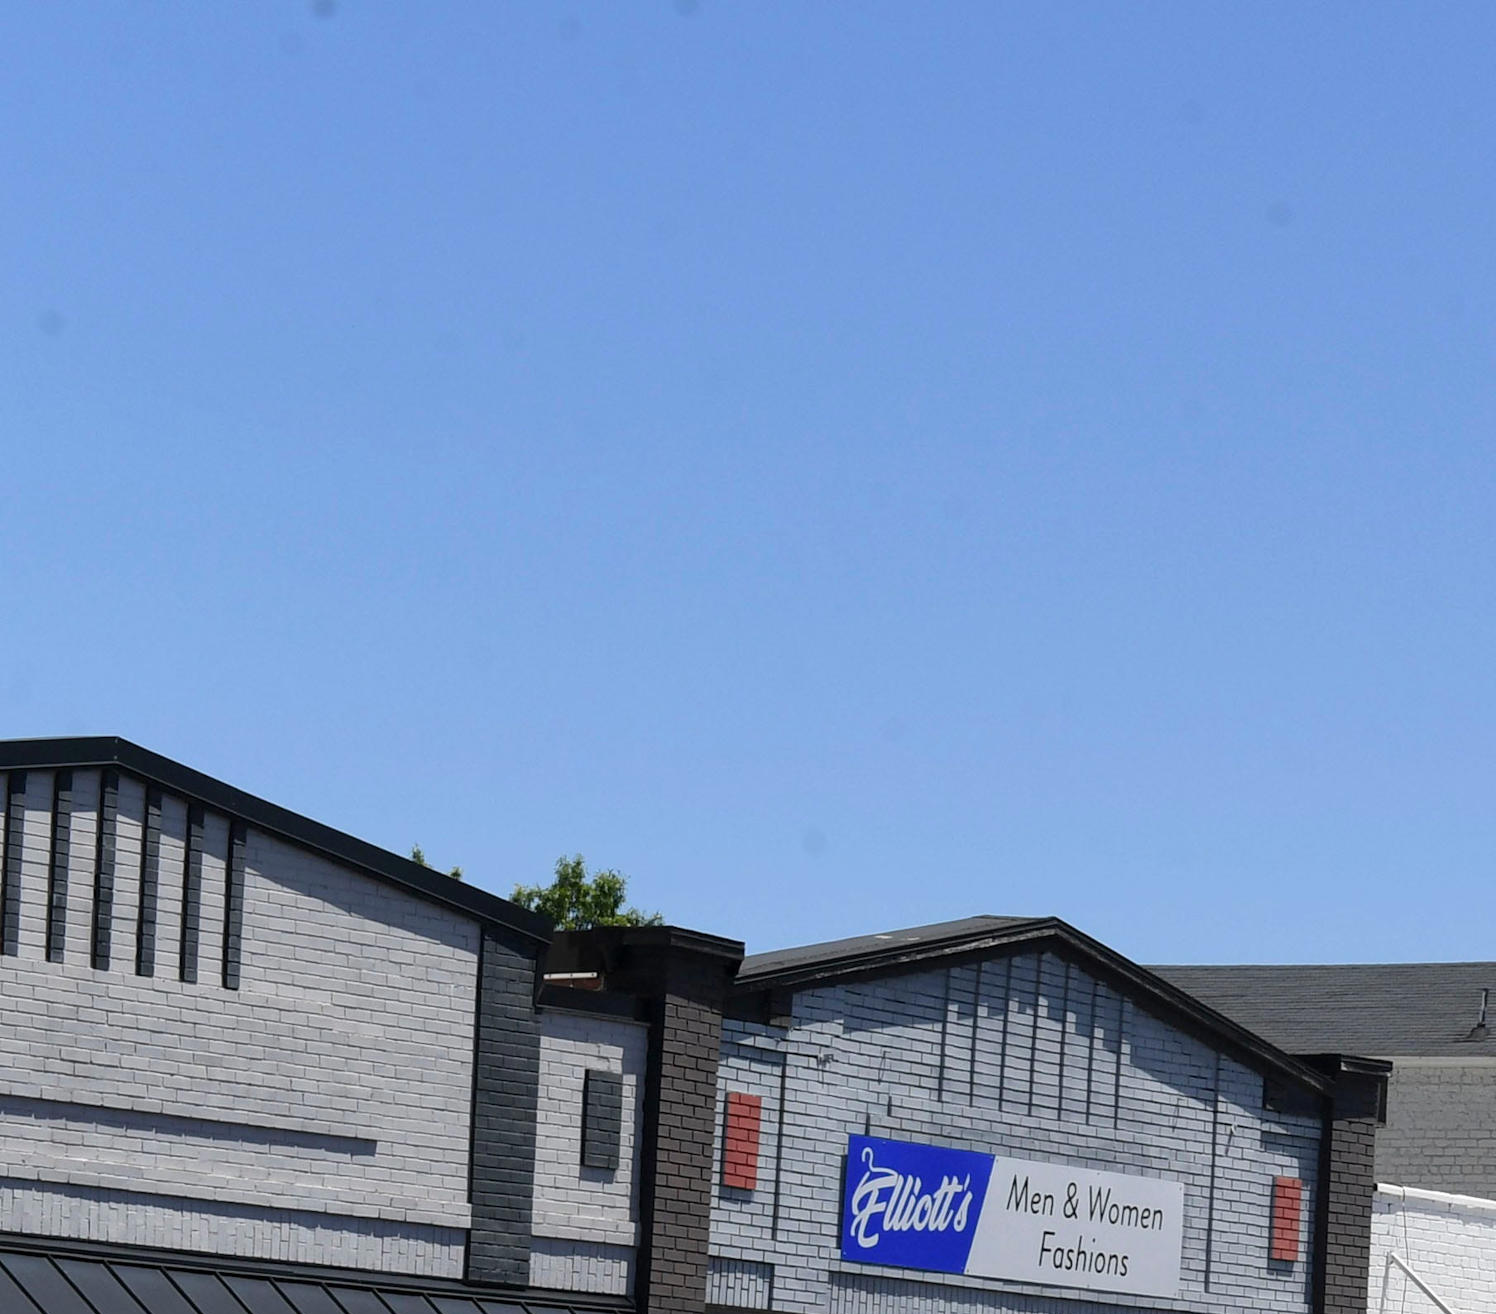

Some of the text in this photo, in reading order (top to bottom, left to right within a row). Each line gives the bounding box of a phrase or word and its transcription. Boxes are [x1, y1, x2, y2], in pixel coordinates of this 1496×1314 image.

[850, 1164, 974, 1249] Elliott's
[1006, 1174, 1165, 1231] Men & Women
[1038, 1231, 1130, 1278] Fashions
